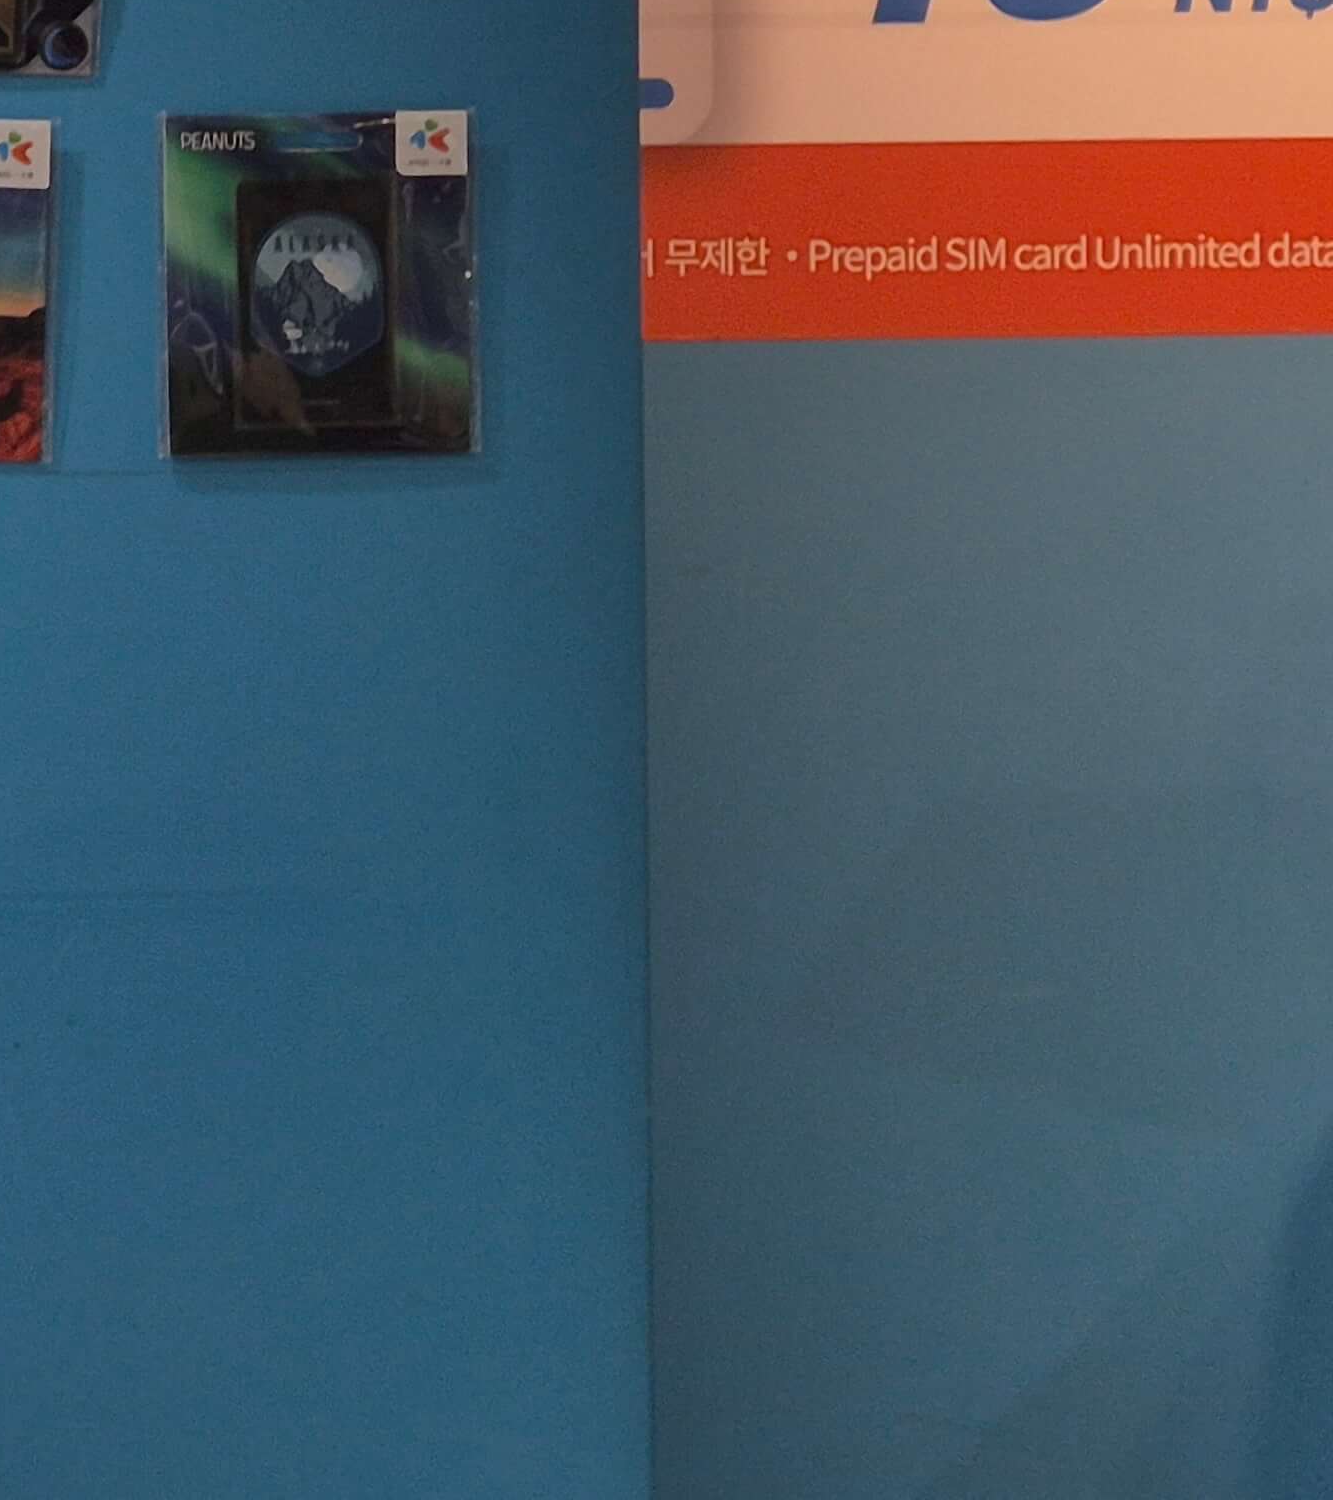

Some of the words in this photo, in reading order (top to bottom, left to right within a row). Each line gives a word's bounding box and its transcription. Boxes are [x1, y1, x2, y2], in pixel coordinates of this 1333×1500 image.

[180, 130, 256, 151] PEANUTS
[665, 236, 771, 277] 무제한
[808, 235, 938, 282] Prepaid
[945, 237, 1007, 272] SIM
[1014, 233, 1087, 271] card
[1096, 233, 1261, 270] Unlimited
[1268, 232, 1333, 270] data
